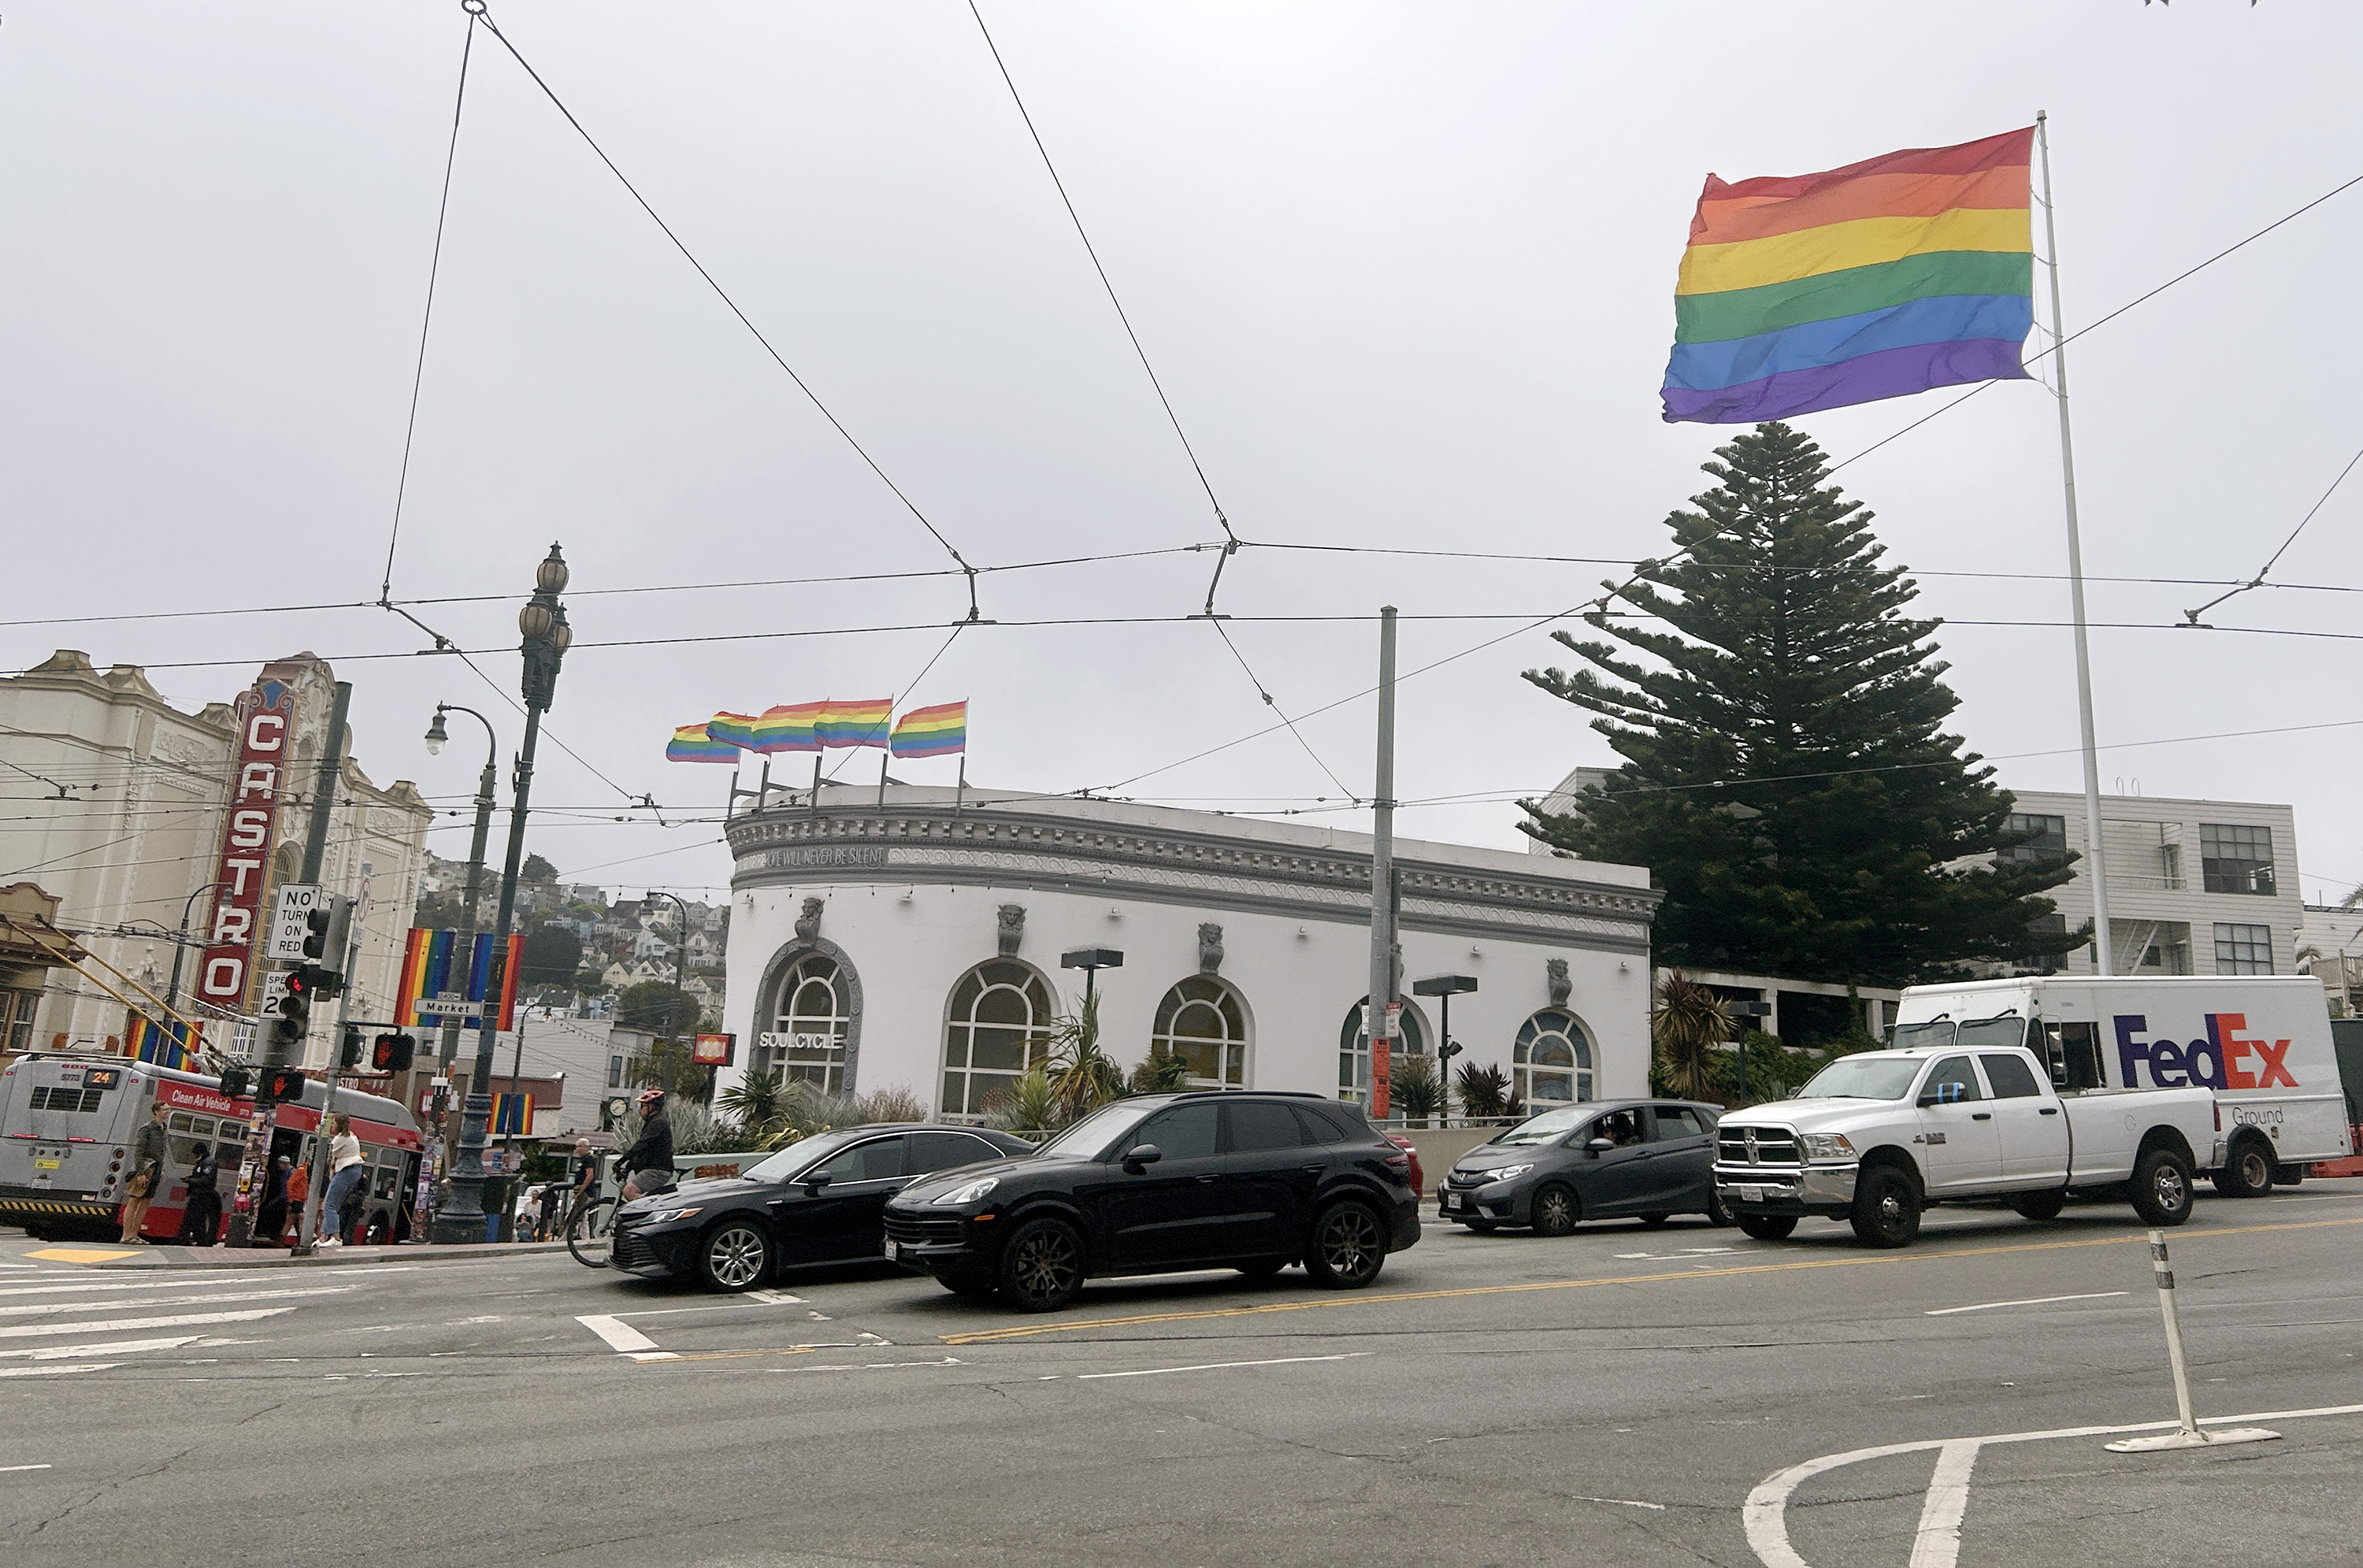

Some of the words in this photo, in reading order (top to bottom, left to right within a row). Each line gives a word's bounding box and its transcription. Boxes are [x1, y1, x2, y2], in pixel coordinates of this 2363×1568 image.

[204, 714, 284, 996] CASTRO
[783, 850, 801, 866] WILL
[803, 848, 833, 865] NEVER
[835, 847, 847, 865] BE
[849, 847, 884, 864] SILENT
[286, 891, 311, 906] NO
[282, 910, 309, 921] TURN
[285, 925, 302, 936] ON
[279, 940, 301, 952] RED
[268, 976, 286, 984] SPE
[263, 995, 284, 1014] 2
[426, 1002, 470, 1014] Market
[759, 1032, 844, 1049] SOULCYCLE
[2113, 1012, 2299, 1090] FedEx
[91, 1071, 109, 1084] 24
[172, 1089, 192, 1105] Clean
[193, 1094, 206, 1106] Air
[206, 1095, 231, 1112] Vehicle
[2232, 1106, 2284, 1126] Ground
